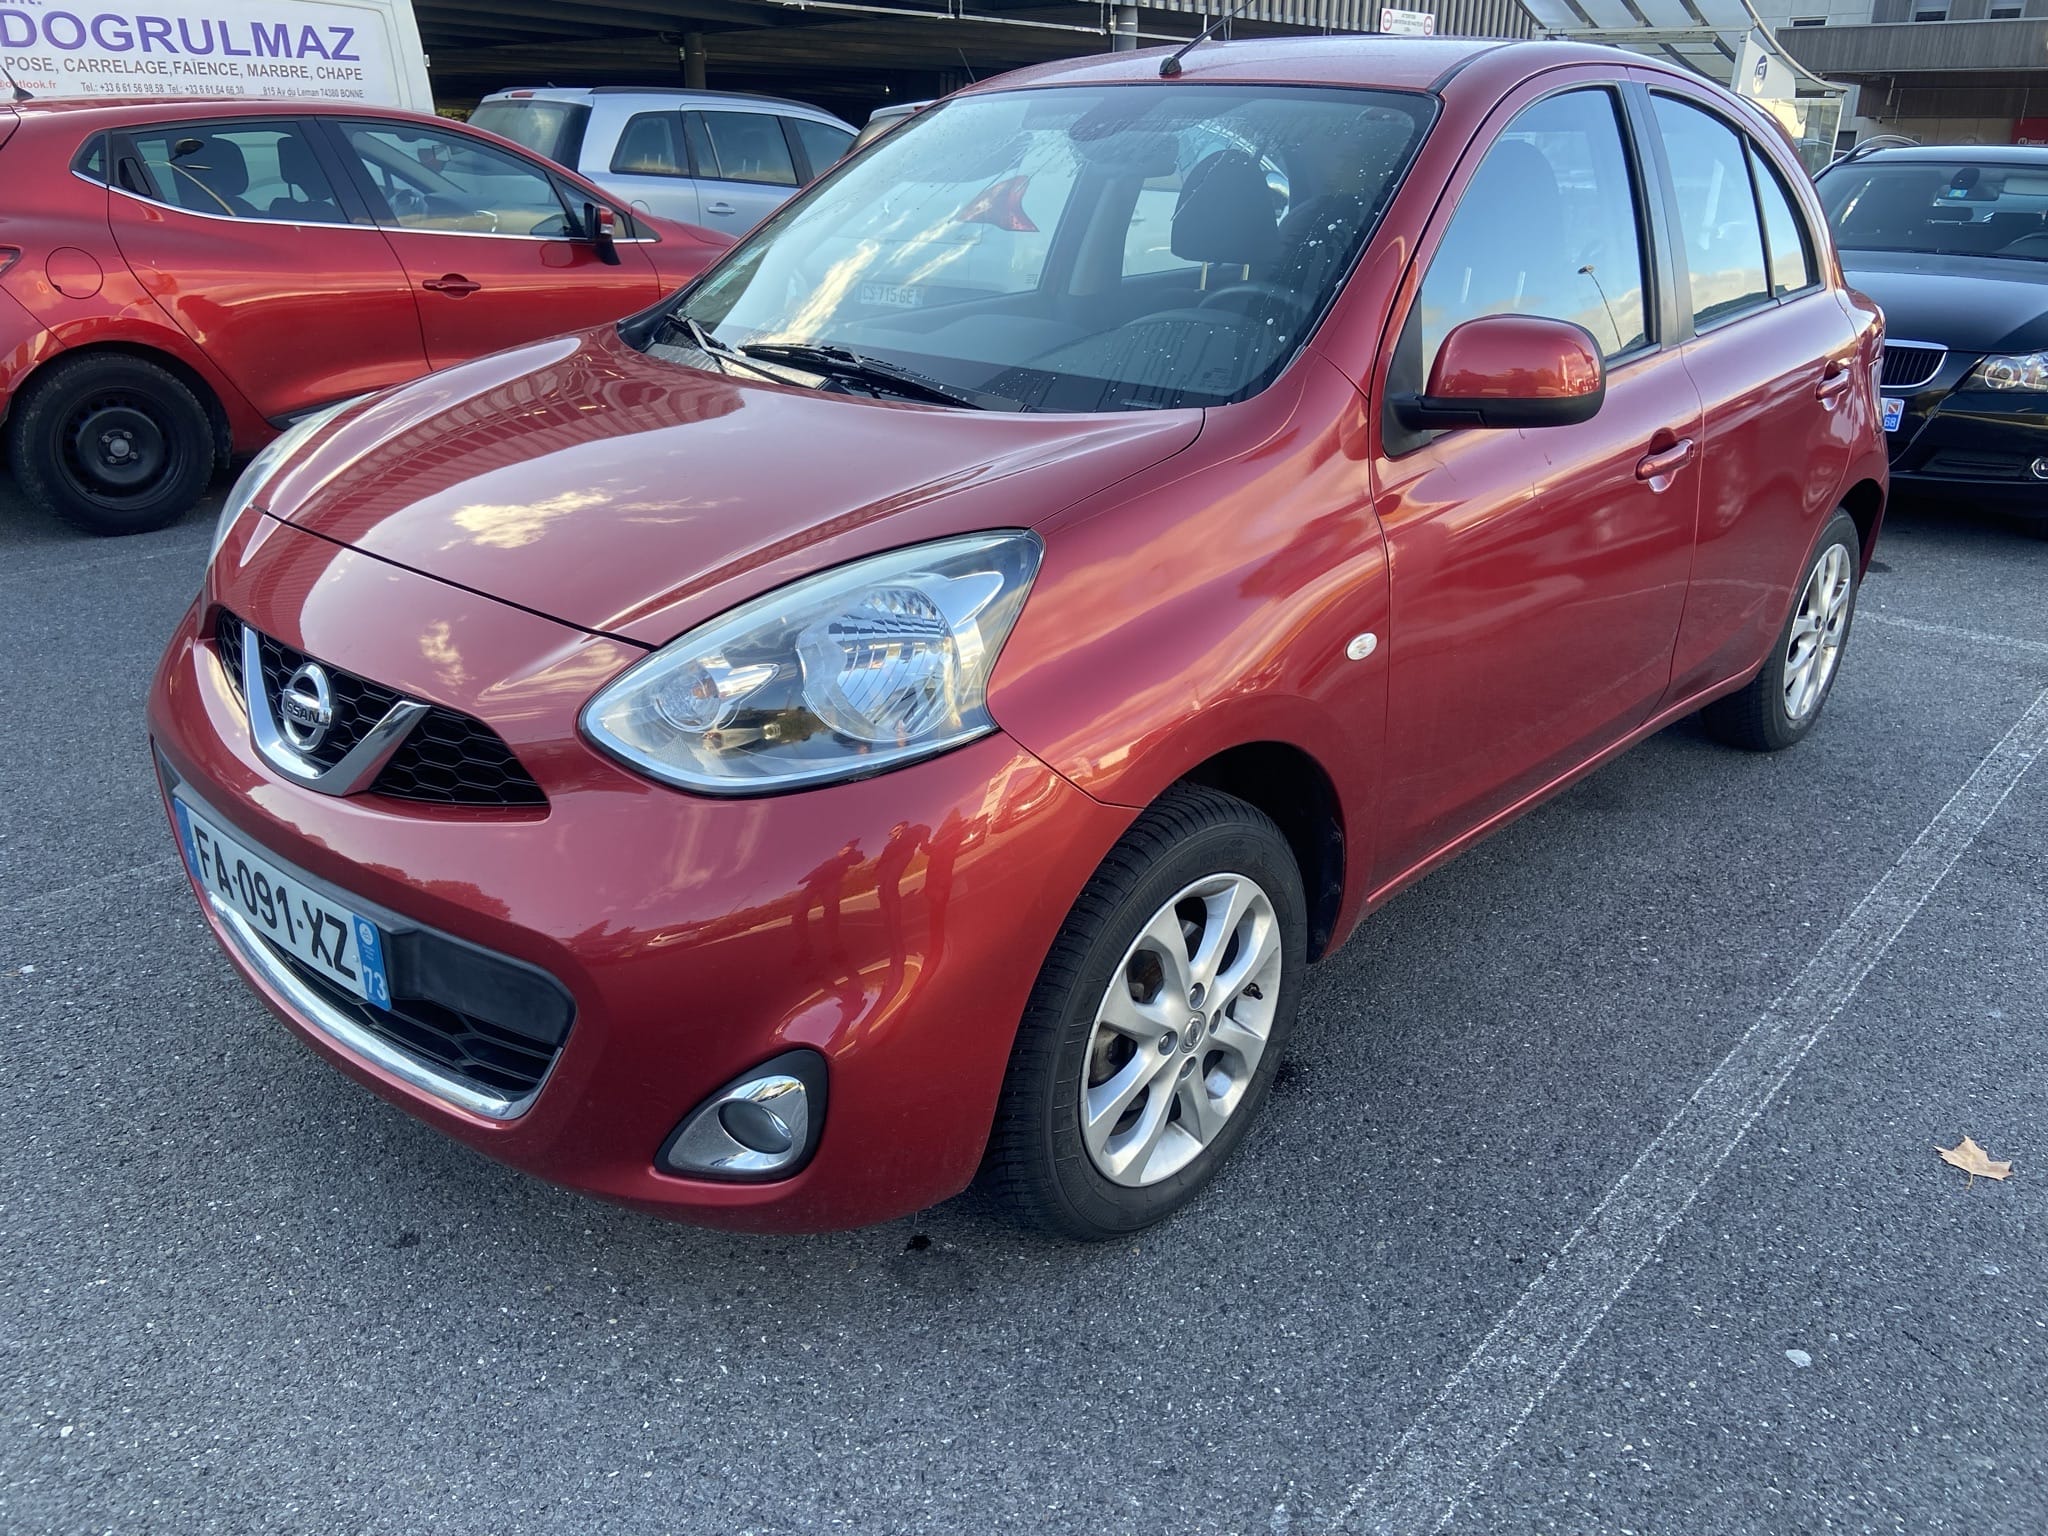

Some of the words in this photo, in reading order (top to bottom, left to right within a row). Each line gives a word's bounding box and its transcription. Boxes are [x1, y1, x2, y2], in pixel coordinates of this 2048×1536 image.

[0, 9, 361, 62] DOGRULMAZ
[4, 56, 59, 75] POSE,
[246, 63, 314, 80] MARBRE,
[316, 66, 364, 81] CHAPE
[1884, 416, 1897, 428] 68
[194, 824, 357, 982] FA-091-XZ
[363, 964, 387, 1001] 73
